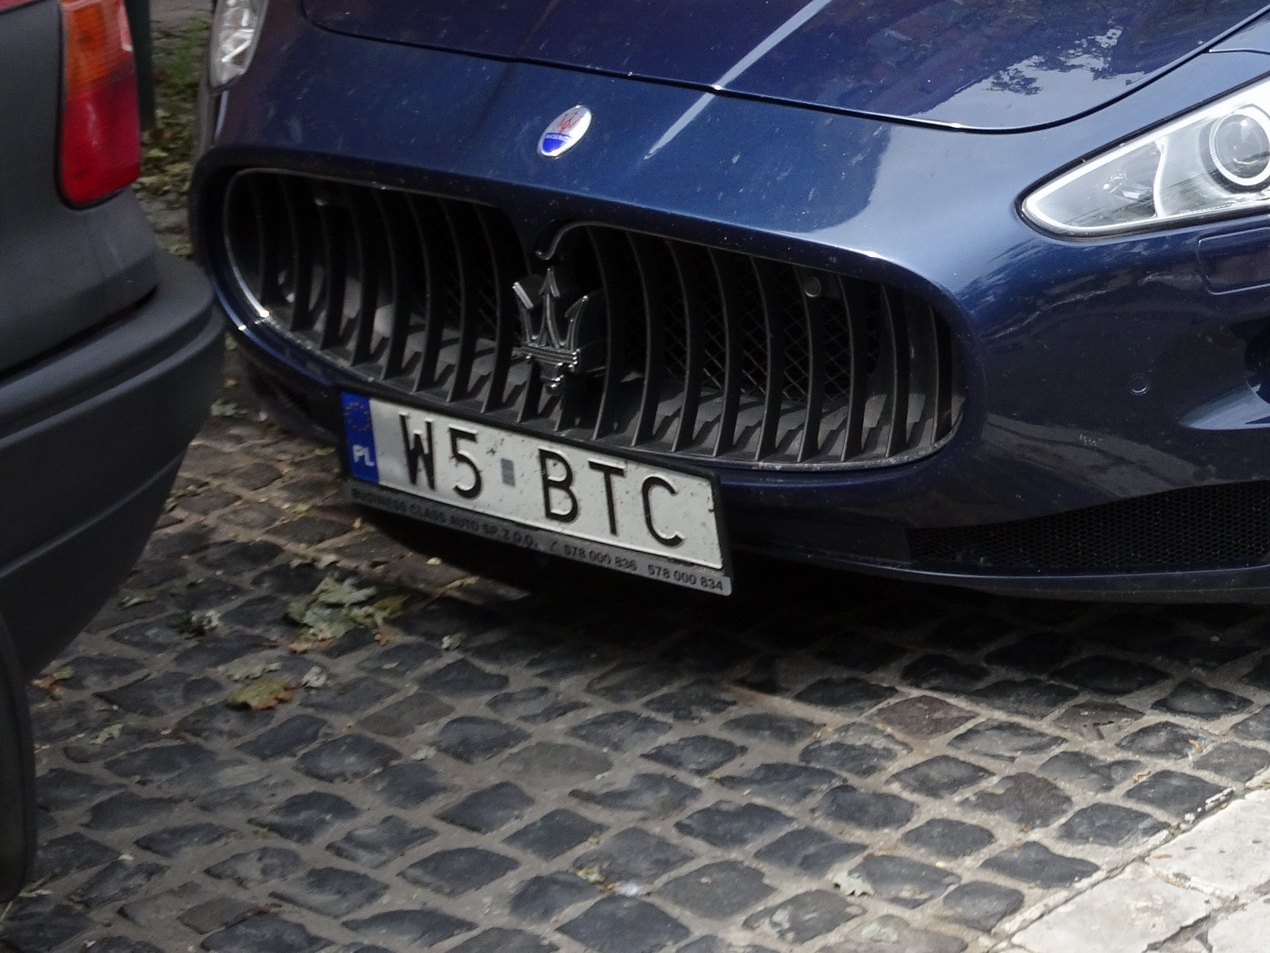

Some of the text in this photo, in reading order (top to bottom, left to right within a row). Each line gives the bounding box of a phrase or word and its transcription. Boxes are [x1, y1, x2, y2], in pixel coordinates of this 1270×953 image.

[352, 444, 375, 468] PL
[399, 411, 686, 548] W5 BTC
[588, 550, 611, 566] 000
[648, 563, 670, 579] 578
[674, 569, 697, 585] 000
[700, 576, 723, 591] 834
